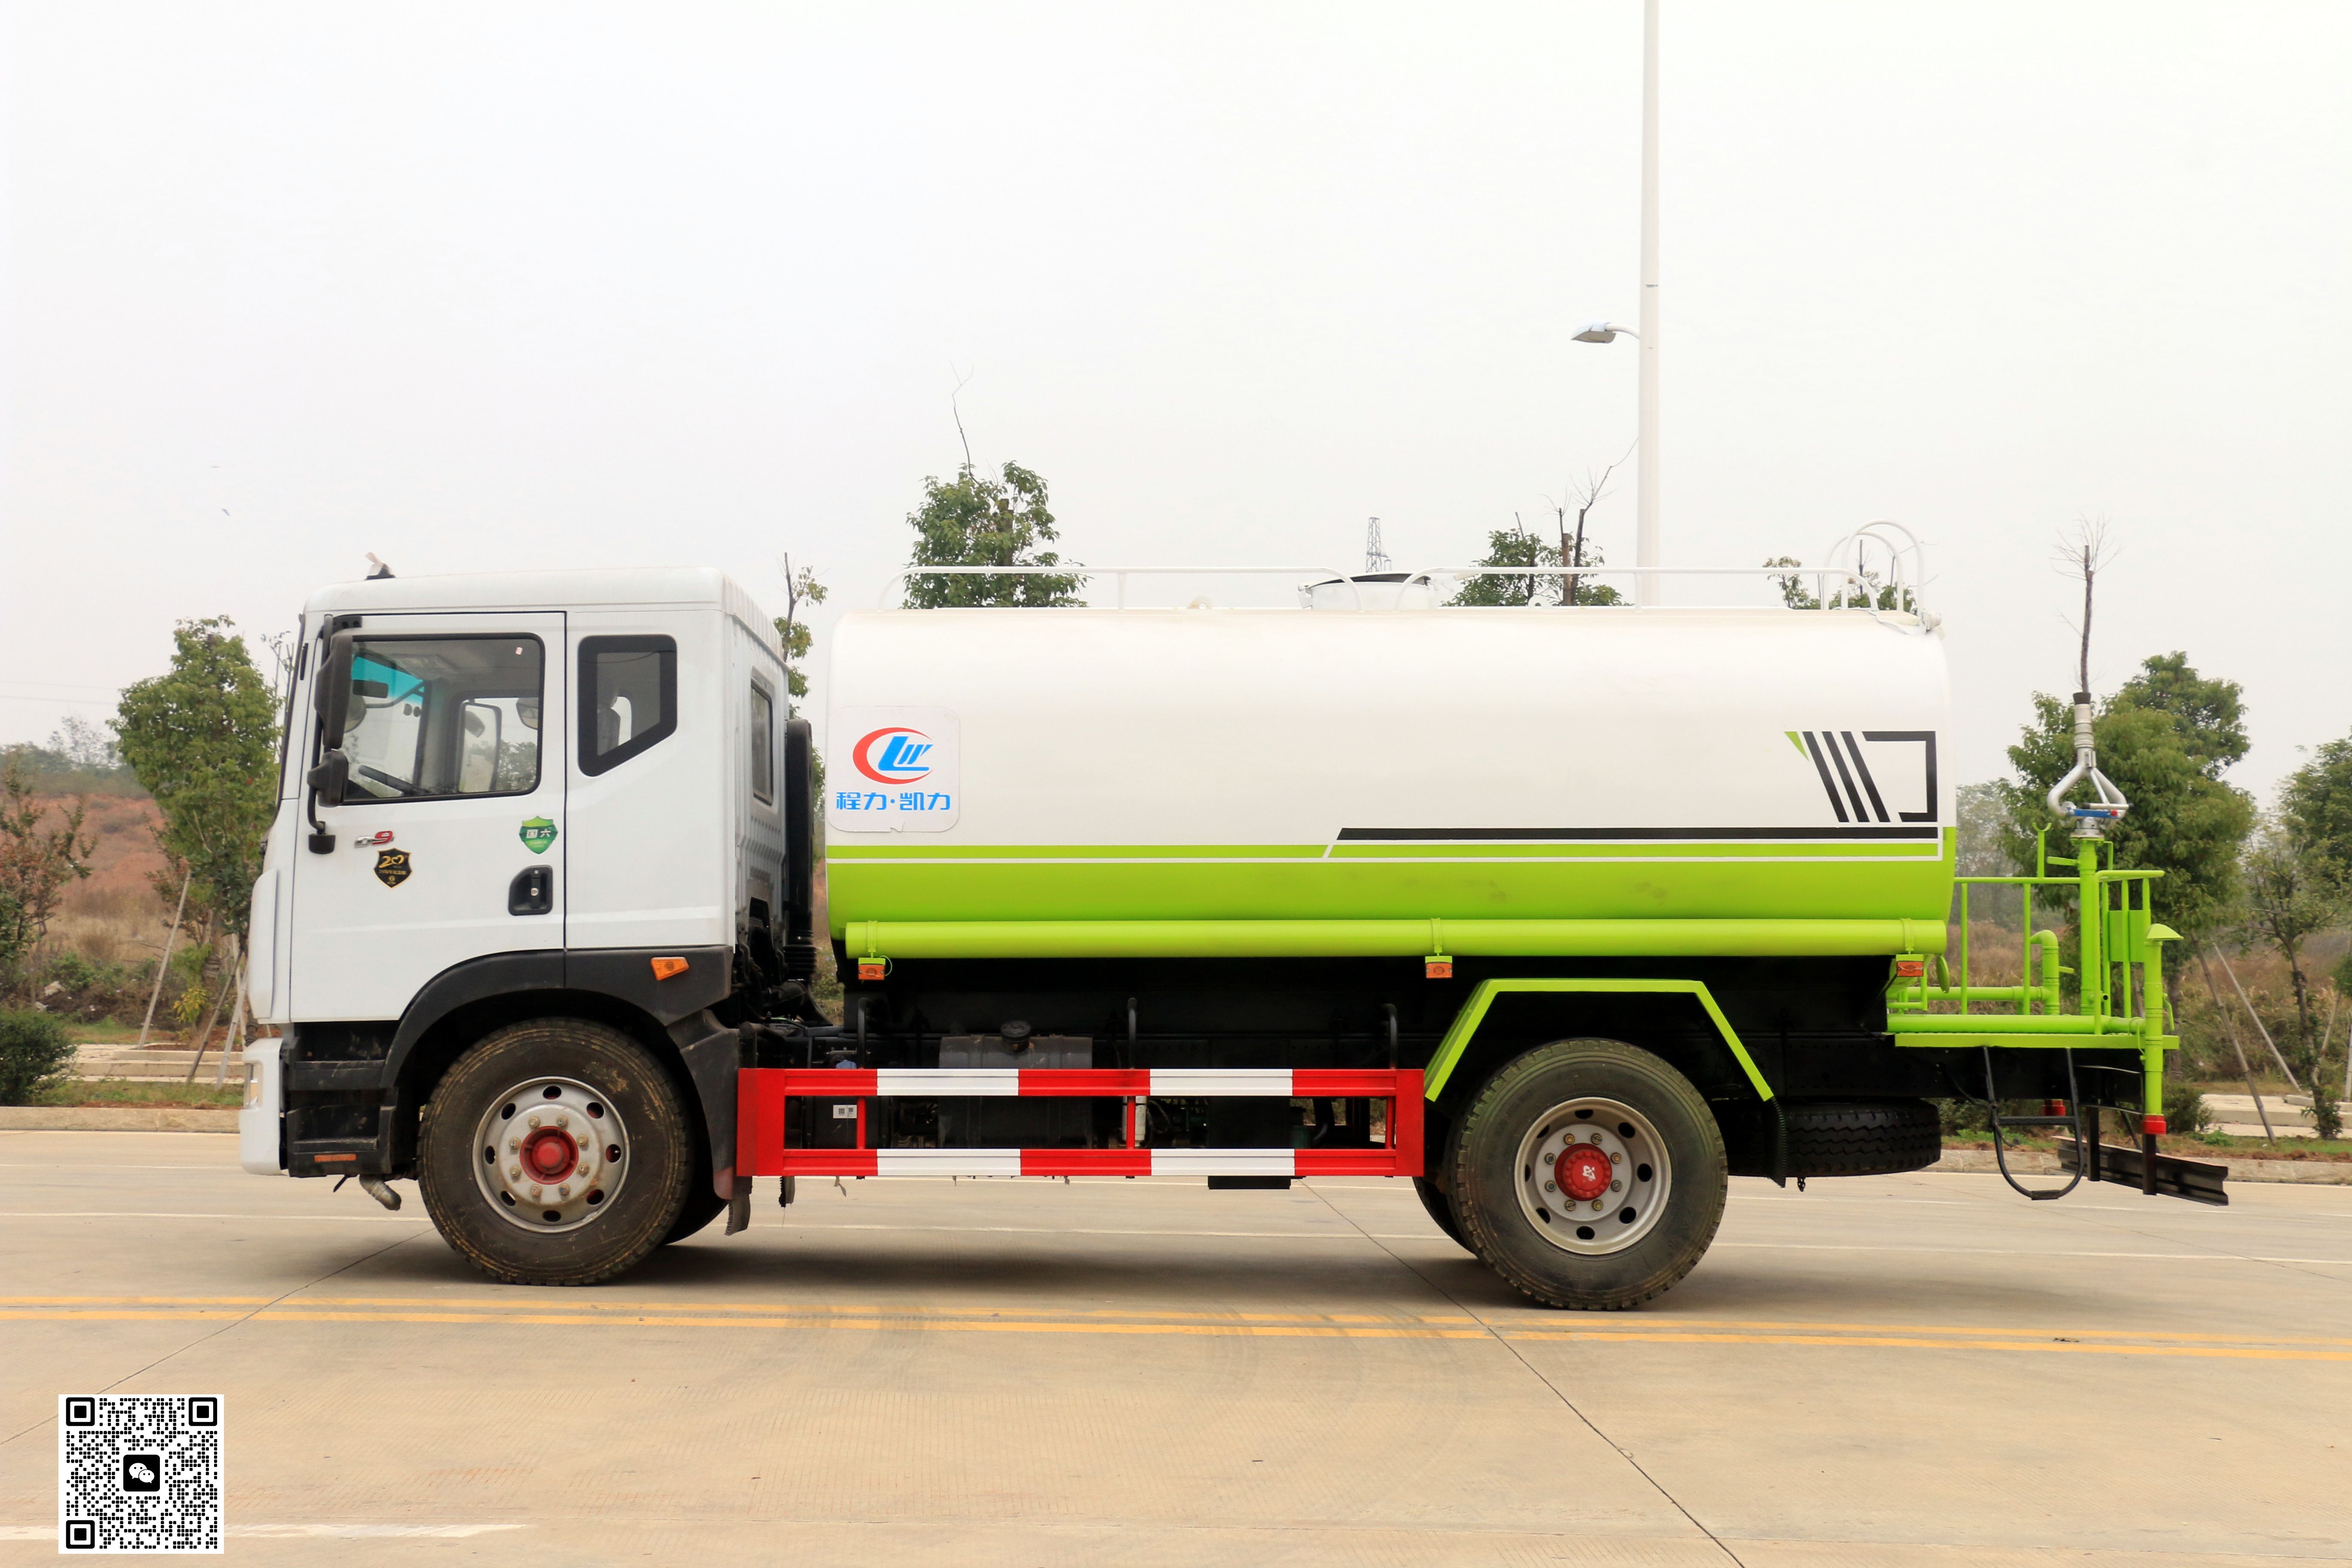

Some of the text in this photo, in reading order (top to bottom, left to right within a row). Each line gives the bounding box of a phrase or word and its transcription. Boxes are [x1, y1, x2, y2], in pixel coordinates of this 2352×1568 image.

[836, 792, 950, 811] 程力·凯力
[526, 829, 551, 839] 国六
[379, 854, 404, 868] 20
